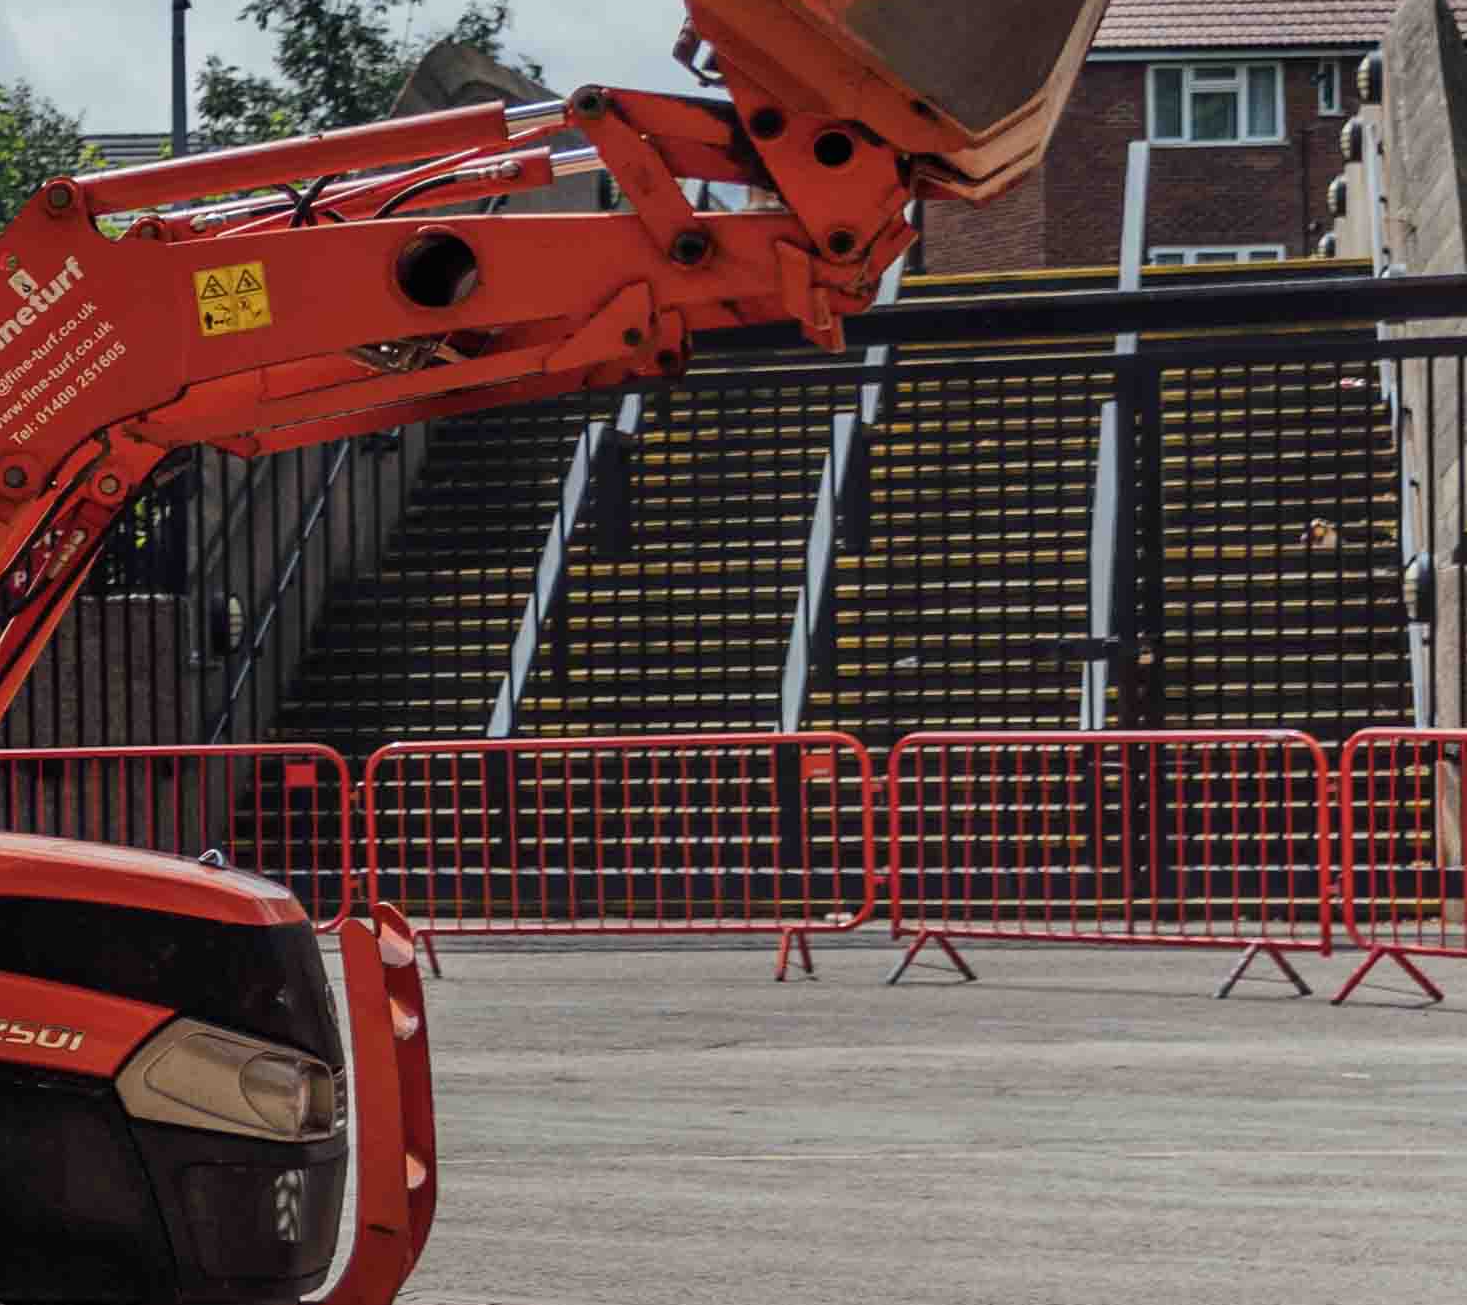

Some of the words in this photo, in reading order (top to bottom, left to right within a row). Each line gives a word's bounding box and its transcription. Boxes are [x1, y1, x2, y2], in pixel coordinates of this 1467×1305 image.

[9, 418, 39, 446] Tel:
[36, 384, 78, 426] 01400
[76, 341, 127, 389] 251605
